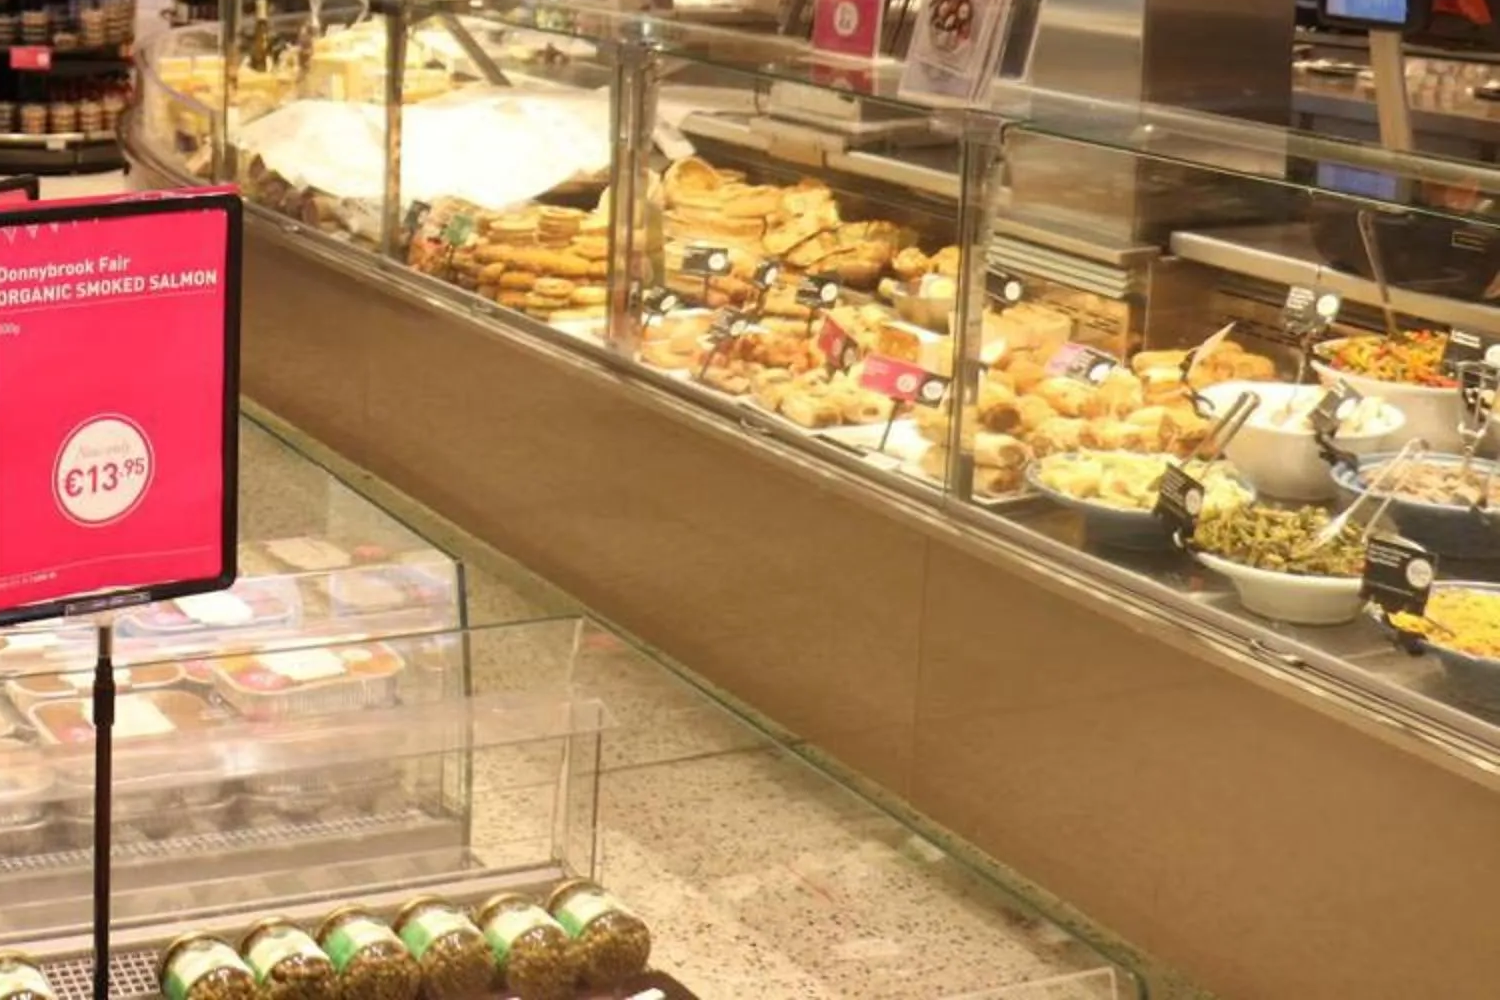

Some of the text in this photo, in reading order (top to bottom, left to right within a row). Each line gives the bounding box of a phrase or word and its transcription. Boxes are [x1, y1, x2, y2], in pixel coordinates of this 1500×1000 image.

[99, 255, 131, 273] Fair
[76, 276, 145, 299] SMOKED
[149, 269, 217, 290] SALMON
